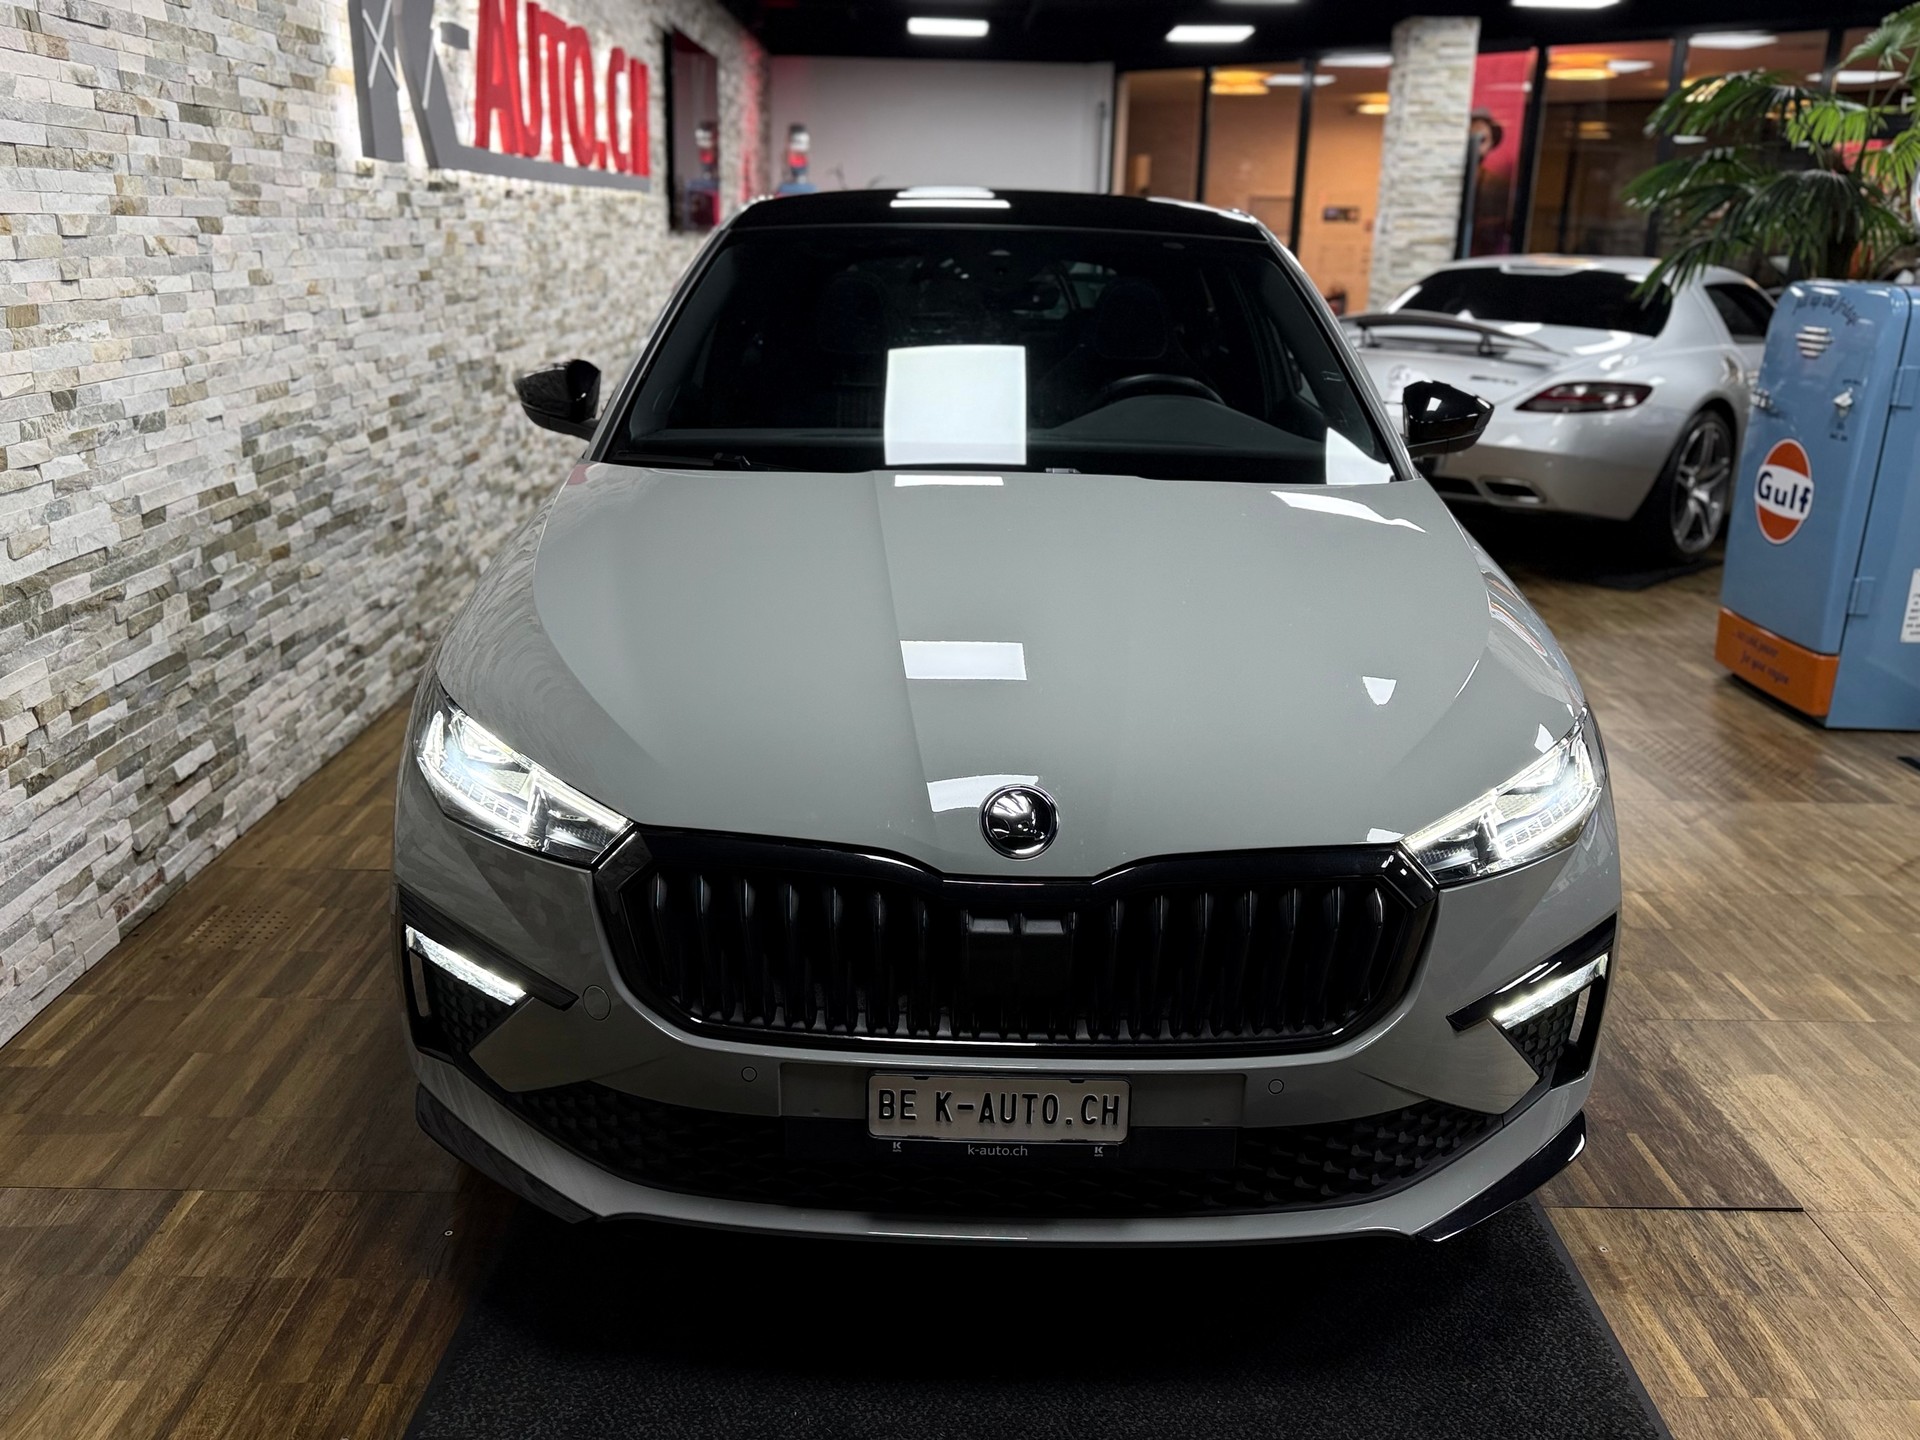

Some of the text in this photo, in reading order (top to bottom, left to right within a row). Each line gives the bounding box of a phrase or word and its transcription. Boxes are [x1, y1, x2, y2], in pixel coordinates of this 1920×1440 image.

[1758, 470, 1811, 514] Gulf
[878, 1089, 1120, 1126] BE K-AUTO.CH
[967, 1144, 1028, 1156] k-auto.ch
